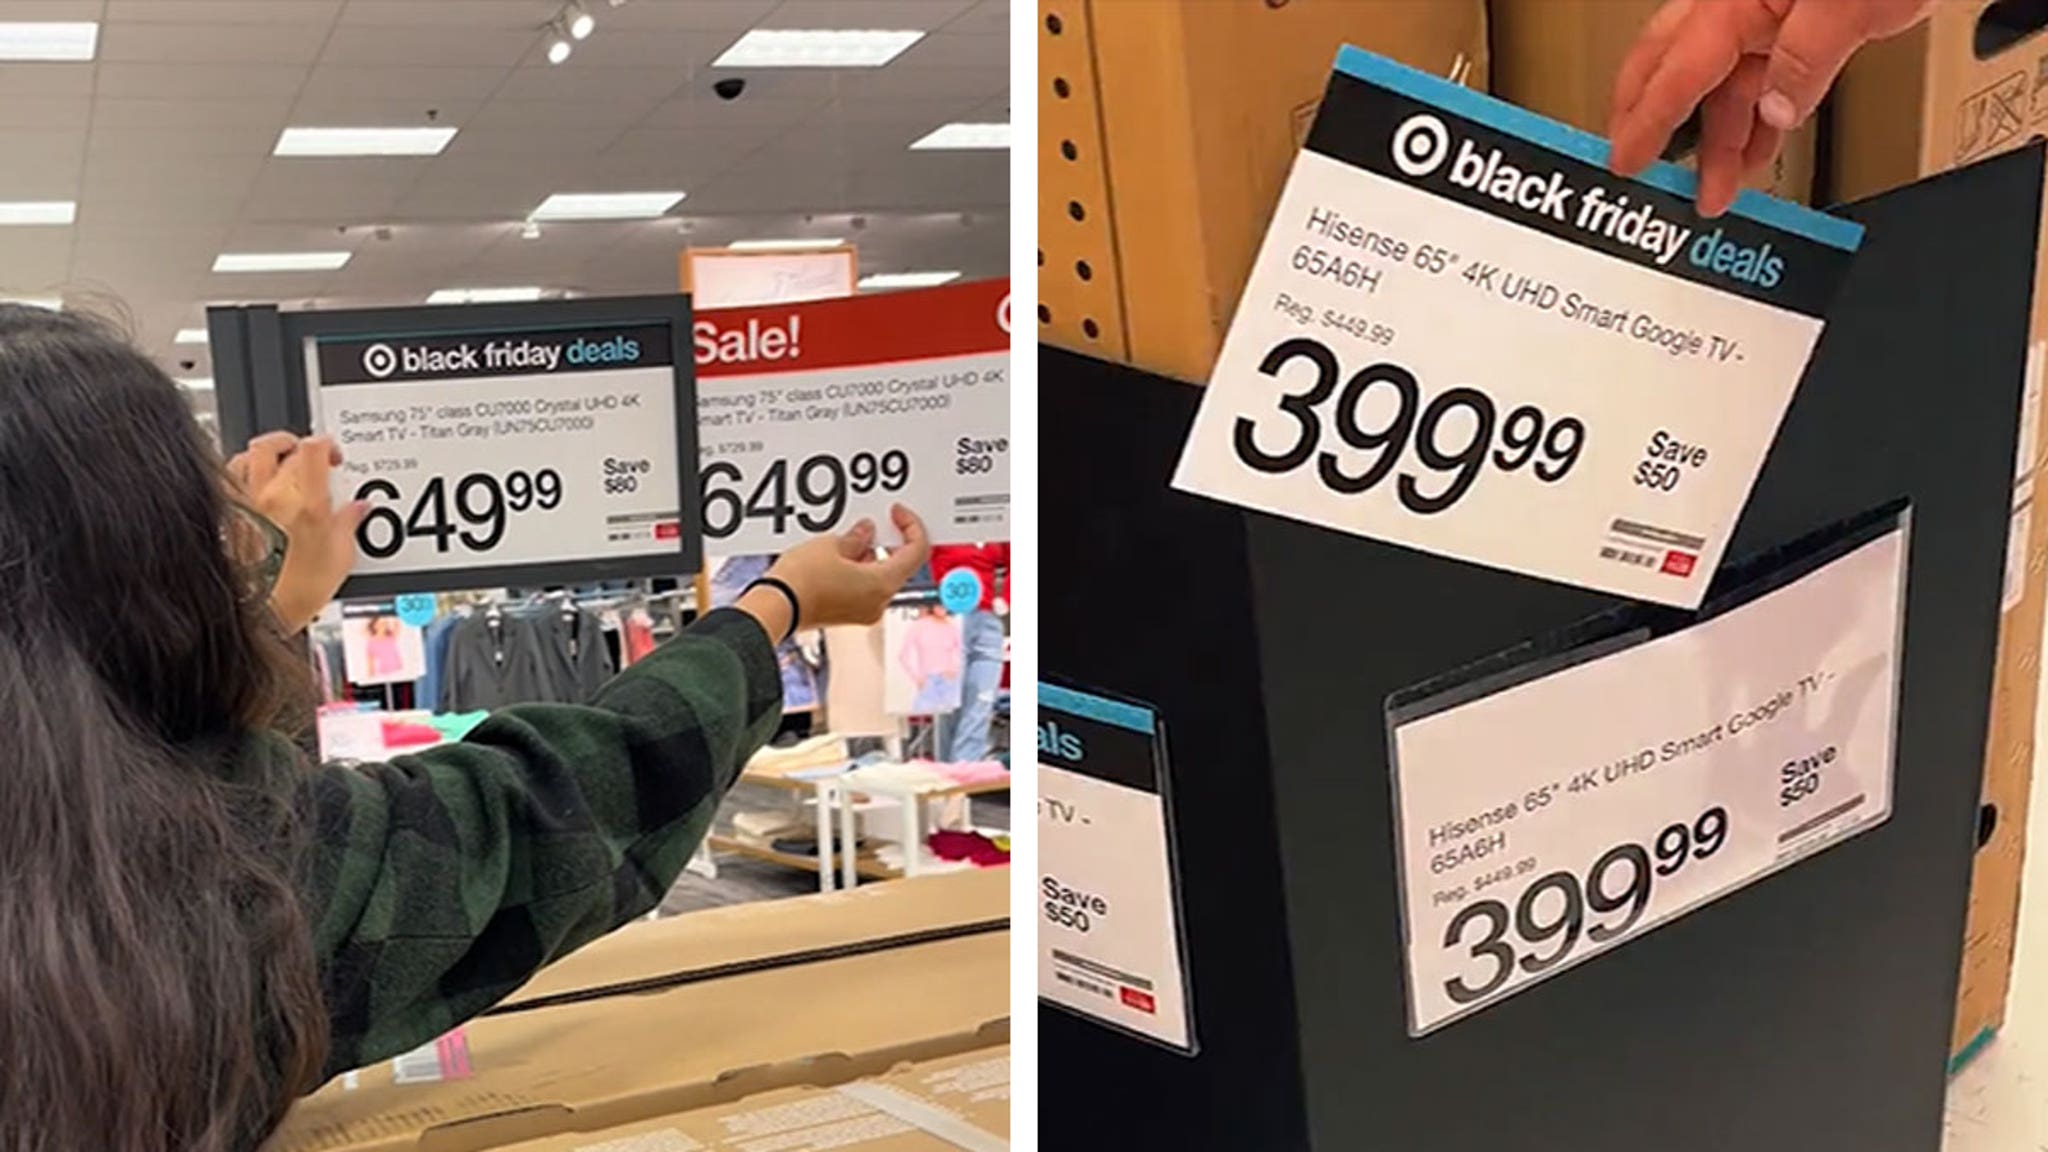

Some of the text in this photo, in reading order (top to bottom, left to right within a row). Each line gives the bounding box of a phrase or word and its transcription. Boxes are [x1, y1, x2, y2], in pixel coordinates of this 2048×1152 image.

[1448, 139, 1785, 289] black friday deals
[1292, 244, 1383, 294] 65A6H
[1305, 206, 1409, 262] Hisense
[1461, 261, 1499, 292] 4K
[1500, 272, 1560, 311] UHD
[1560, 292, 1630, 333] Smart
[1630, 314, 1704, 356] Google
[1707, 335, 1738, 362] TV
[1273, 292, 1396, 347] Reg. $449.99
[403, 335, 641, 372] black friday deals
[692, 314, 801, 365] Sale!
[697, 393, 757, 409] amsung
[786, 388, 823, 402] class
[886, 376, 938, 395] Crystal
[941, 371, 979, 389] UHD
[982, 369, 1005, 383] 4K
[339, 408, 406, 425] Samsung
[436, 405, 473, 419] class
[534, 397, 580, 414] Crystal
[584, 396, 618, 411] UHD
[621, 394, 641, 407] 4K
[698, 411, 735, 427] mart
[735, 410, 754, 424] TV
[768, 408, 802, 423] Titan
[805, 406, 840, 422] Gray
[341, 428, 386, 444] Smart
[388, 426, 406, 441] TV
[420, 423, 453, 439] Titan
[456, 422, 490, 438] Gray
[956, 436, 1010, 456] Save
[1646, 430, 1708, 468] Save
[603, 457, 651, 475] Save
[954, 455, 993, 476] $80
[1632, 460, 1681, 492] $50
[603, 476, 638, 495] $80
[1428, 802, 1519, 847] Hisense
[1567, 768, 1600, 793] 4K
[1603, 749, 1656, 783] UHD
[1660, 725, 1723, 762] Smart
[1727, 690, 1794, 735] Google
[1797, 671, 1825, 698] TV
[1781, 746, 1838, 784] Save
[1780, 772, 1819, 807] $50
[1045, 798, 1076, 824] TV
[1429, 830, 1506, 875] 65A6H
[1041, 875, 1107, 915] Save
[1044, 900, 1090, 934] $50
